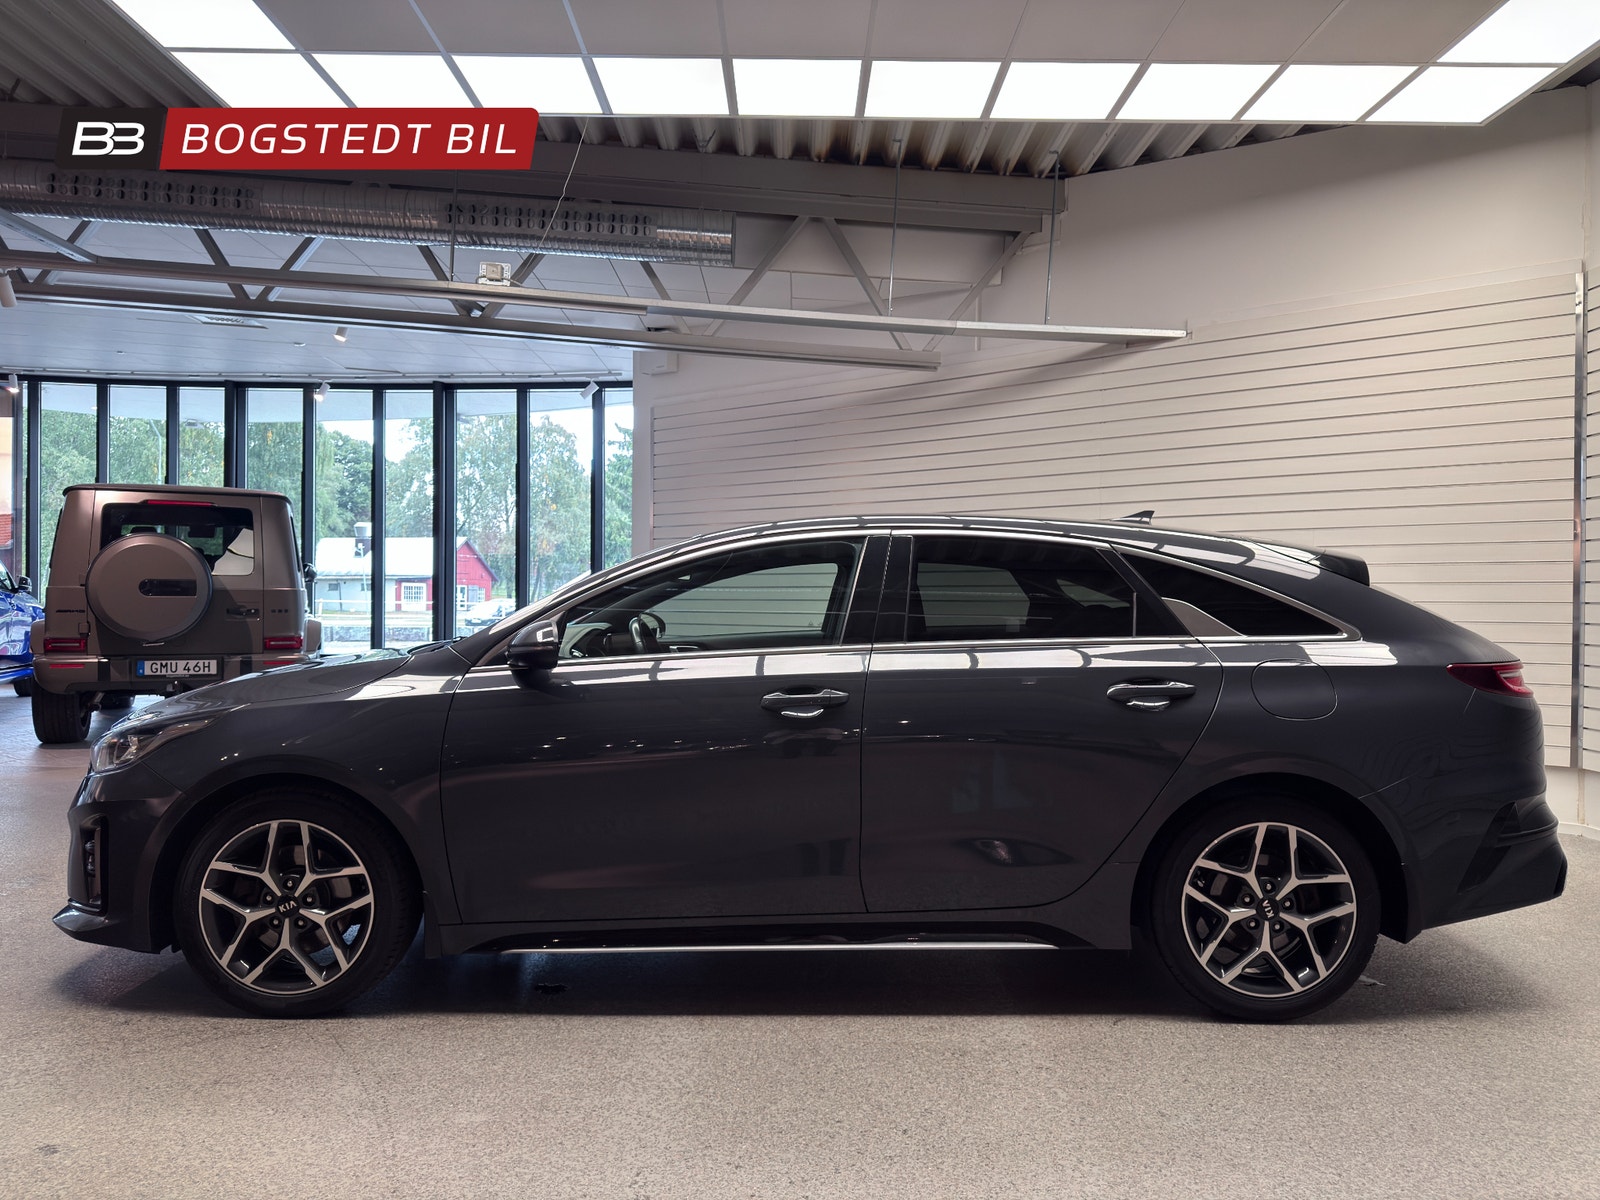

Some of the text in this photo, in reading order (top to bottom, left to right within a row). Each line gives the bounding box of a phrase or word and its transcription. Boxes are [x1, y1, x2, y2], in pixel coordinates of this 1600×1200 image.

[150, 661, 211, 673] GMU 46H
[278, 900, 297, 913] KIA
[1262, 899, 1275, 918] KIA
